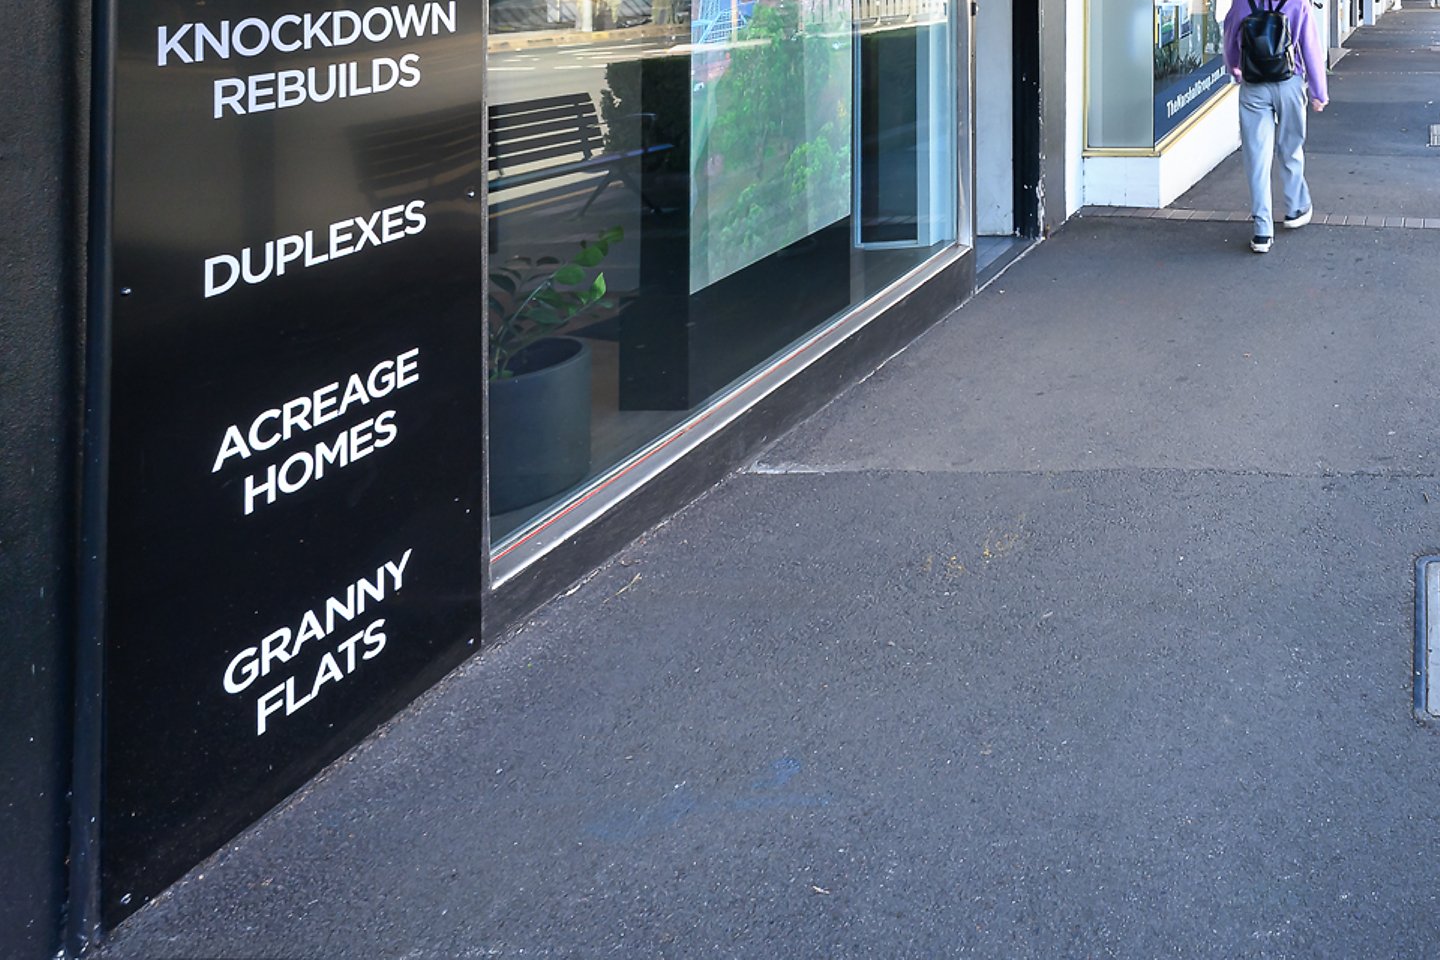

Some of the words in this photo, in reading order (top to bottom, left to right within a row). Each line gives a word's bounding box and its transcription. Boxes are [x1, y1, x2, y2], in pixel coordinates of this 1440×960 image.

[157, 1, 456, 66] KNOCKDOWN
[213, 53, 421, 119] REBUILDS
[204, 200, 426, 298] DUPLEXES
[212, 347, 420, 472] ACREAGE
[243, 410, 398, 515] HOMES
[222, 548, 412, 694] GRANNY
[256, 618, 386, 735] FLATS
